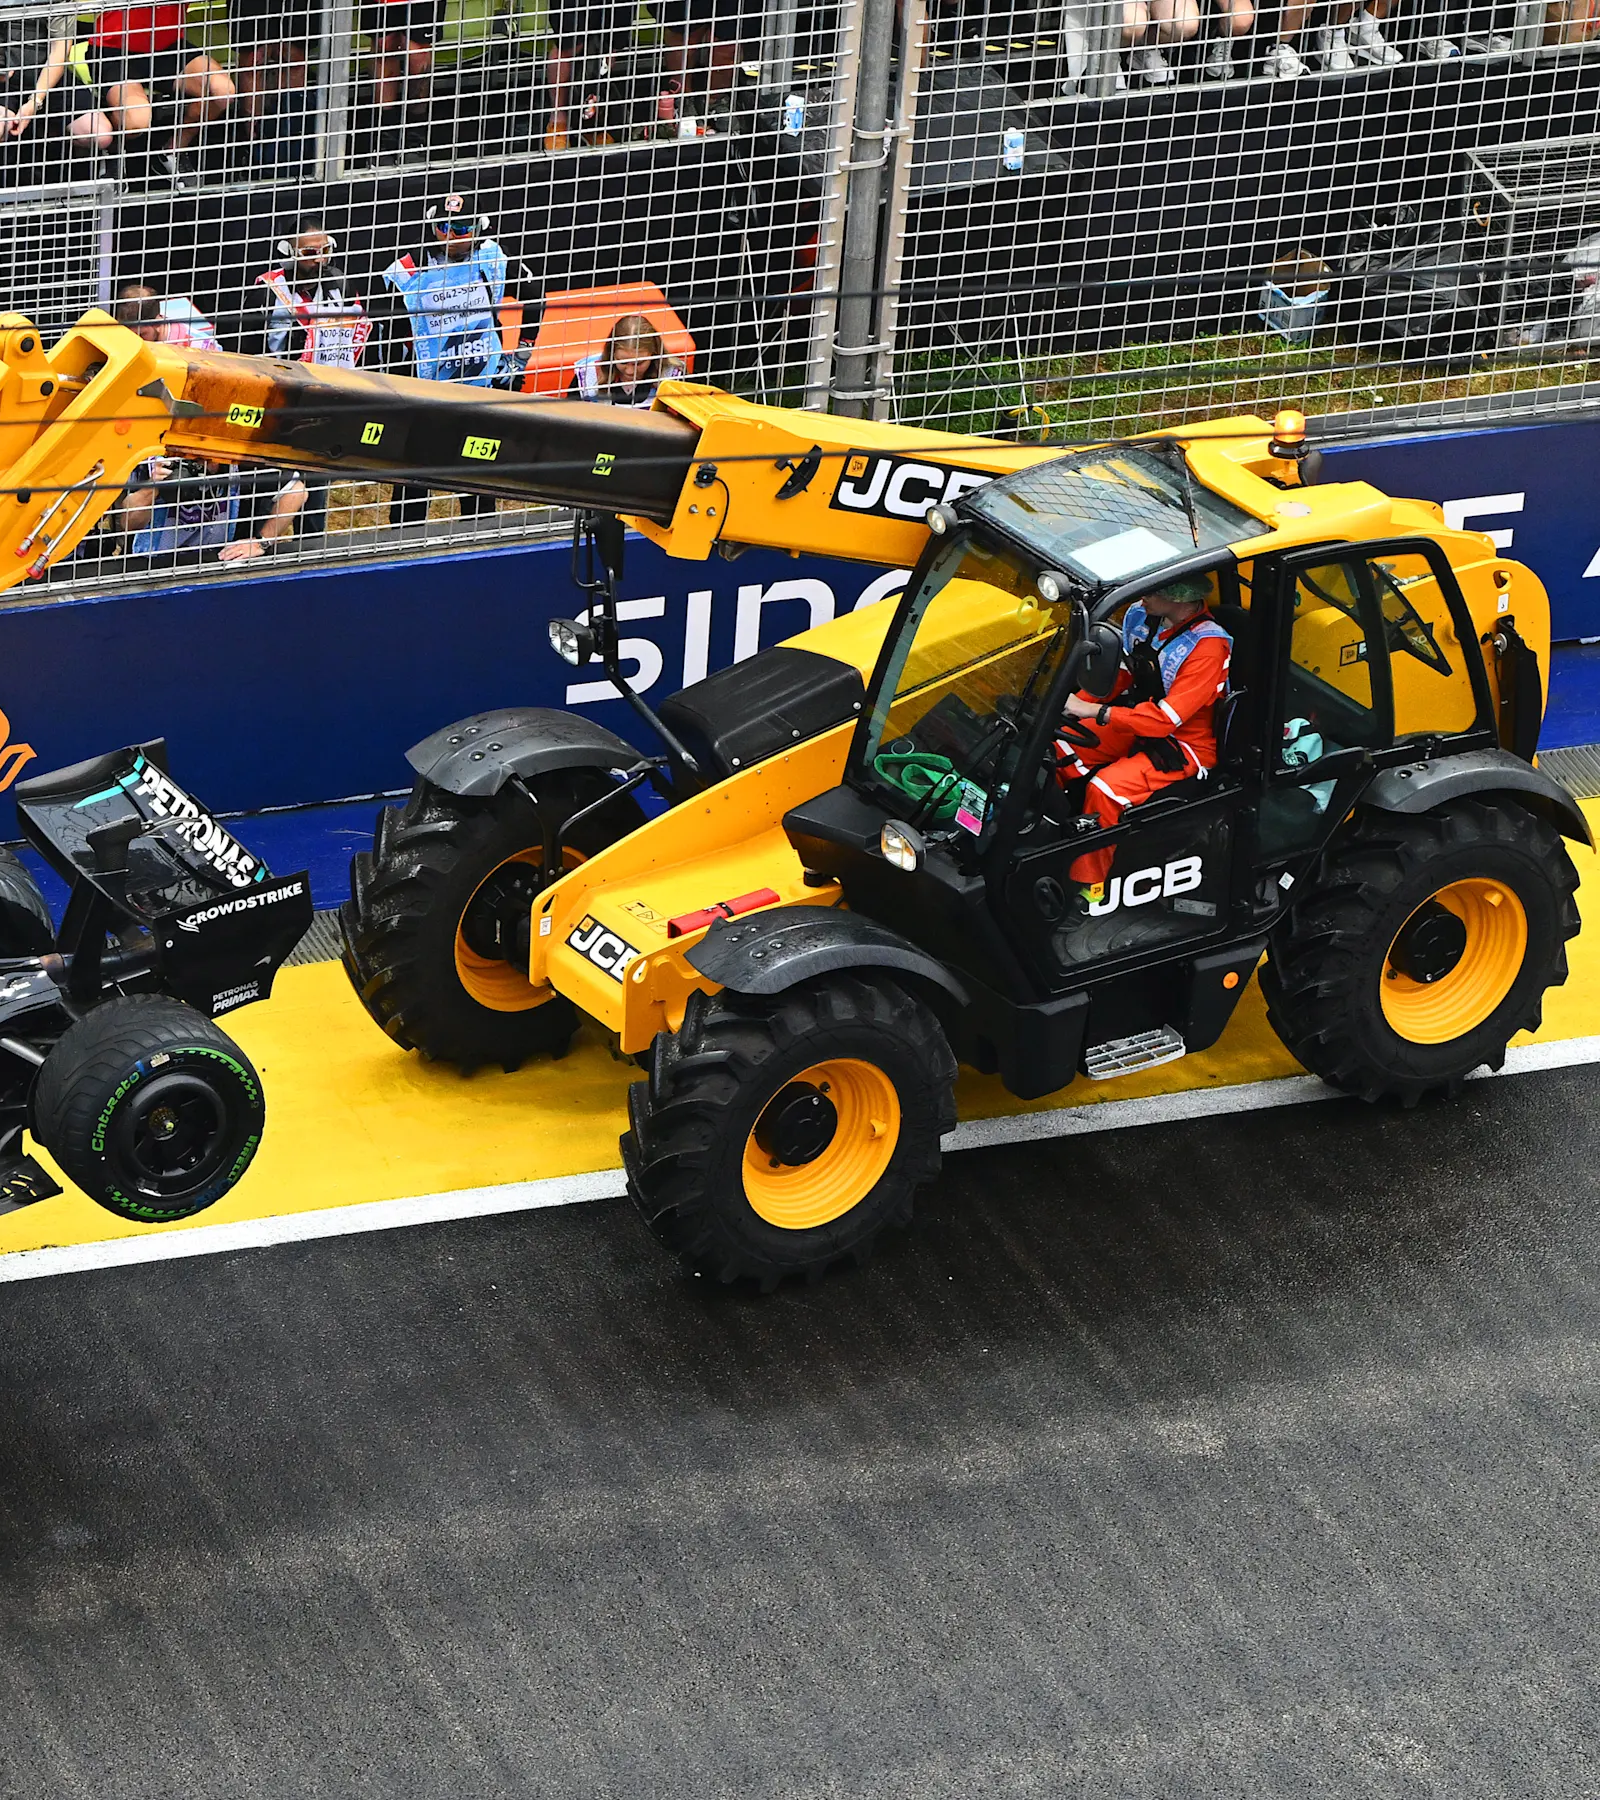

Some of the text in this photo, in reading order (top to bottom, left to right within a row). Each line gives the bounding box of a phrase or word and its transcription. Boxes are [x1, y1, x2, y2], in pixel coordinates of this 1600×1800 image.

[366, 427, 375, 441] 1
[140, 764, 256, 888] PETRONAS
[185, 881, 303, 926] CROWDSTRIKE
[1089, 855, 1203, 917] JCB
[212, 980, 259, 1001] PETRONAS
[212, 988, 260, 1013] PRIMAX
[91, 1070, 140, 1152] Cinturato
